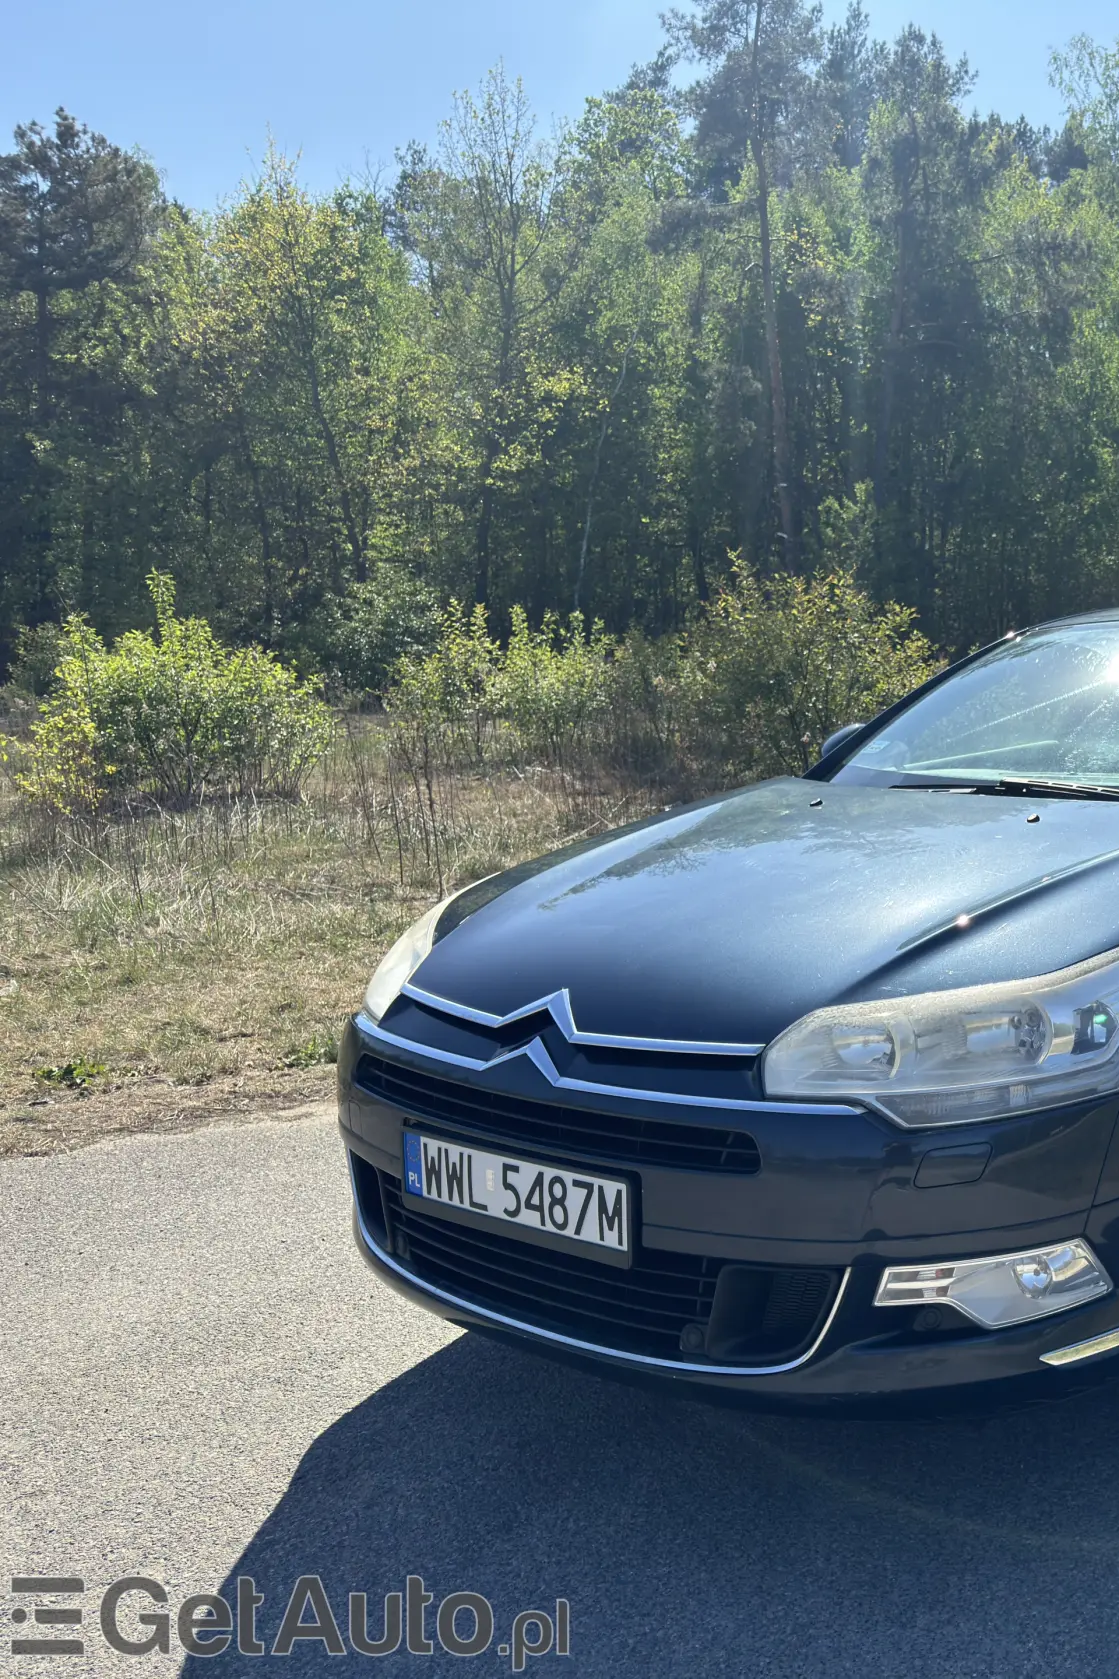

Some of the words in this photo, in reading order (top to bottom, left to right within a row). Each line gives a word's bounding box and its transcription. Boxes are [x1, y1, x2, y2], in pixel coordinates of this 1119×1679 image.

[408, 1171, 420, 1188] PL
[423, 1142, 488, 1212] WWL
[502, 1162, 624, 1247] 5487M
